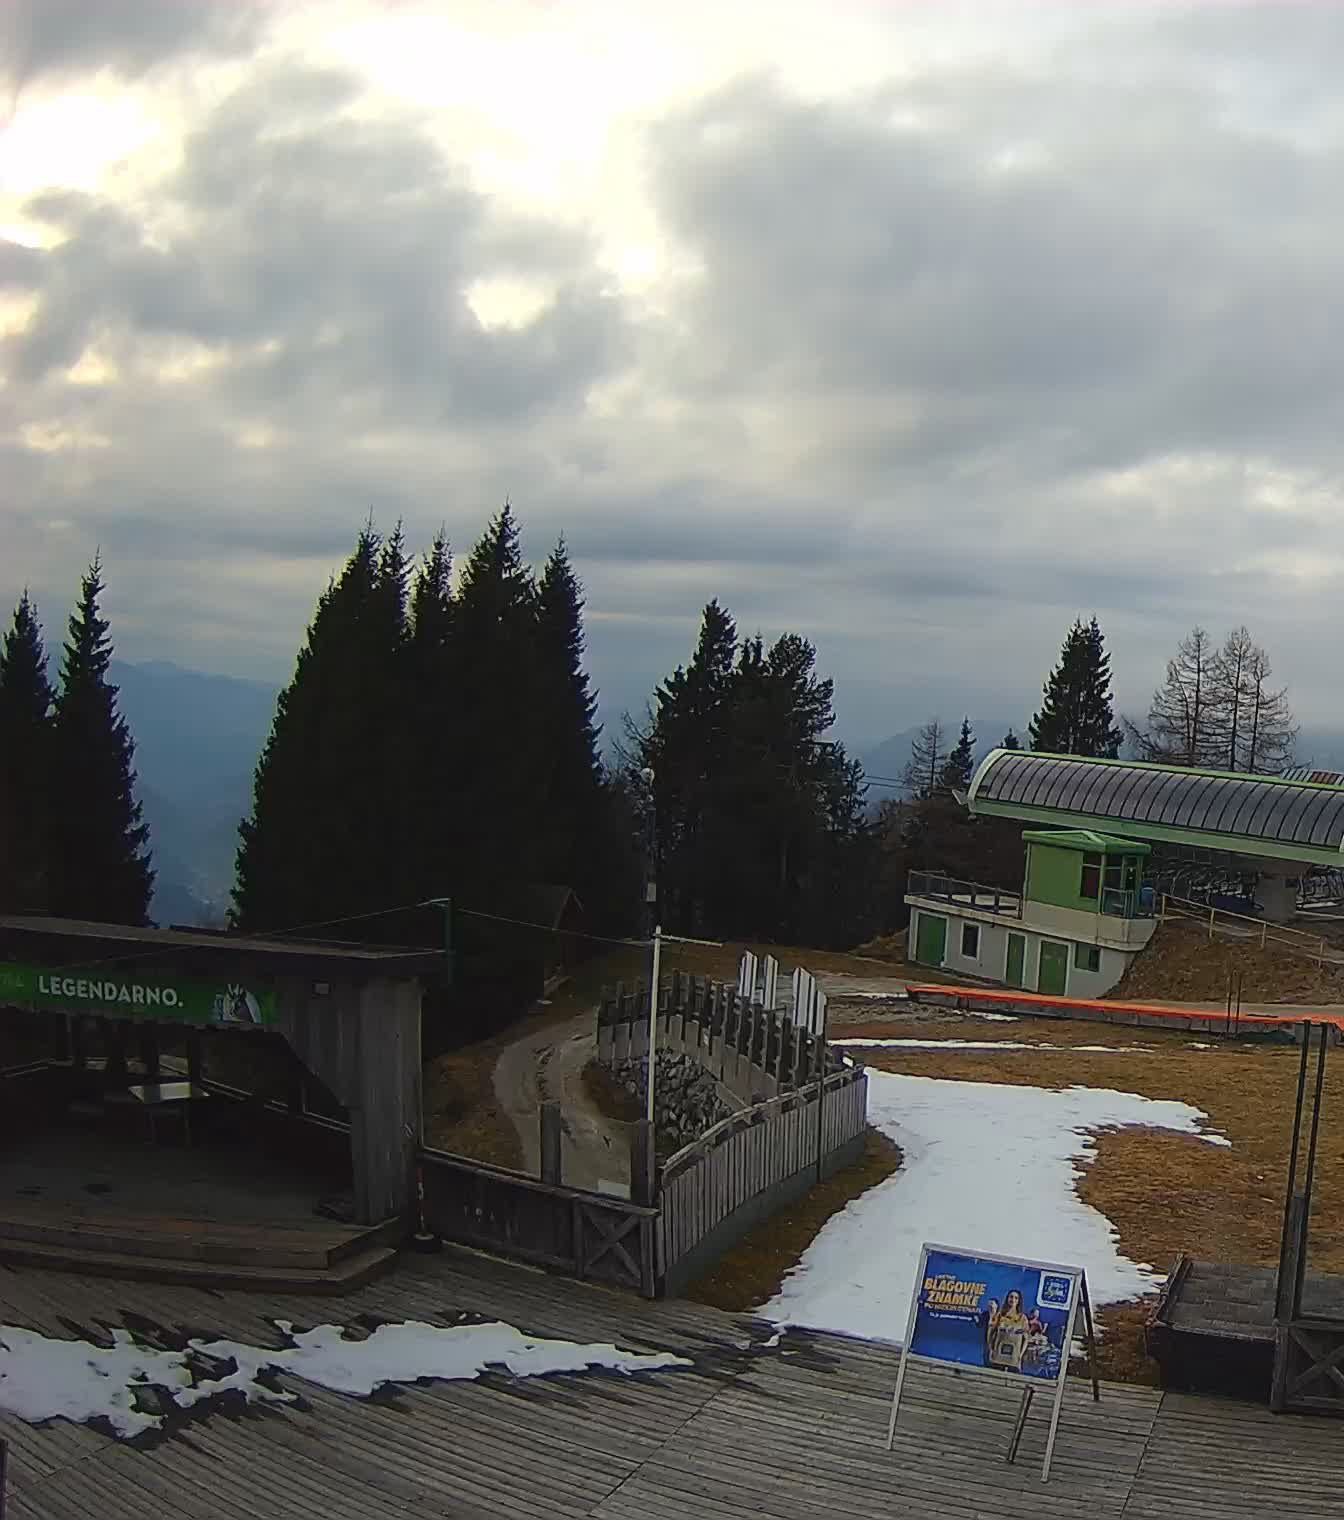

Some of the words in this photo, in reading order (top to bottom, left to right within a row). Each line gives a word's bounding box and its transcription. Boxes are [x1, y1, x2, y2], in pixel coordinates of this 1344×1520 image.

[38, 974, 185, 1008] LEGENDARNO.
[924, 1277, 987, 1295] BLAGOVNE
[927, 1290, 980, 1306] ZNAMKE
